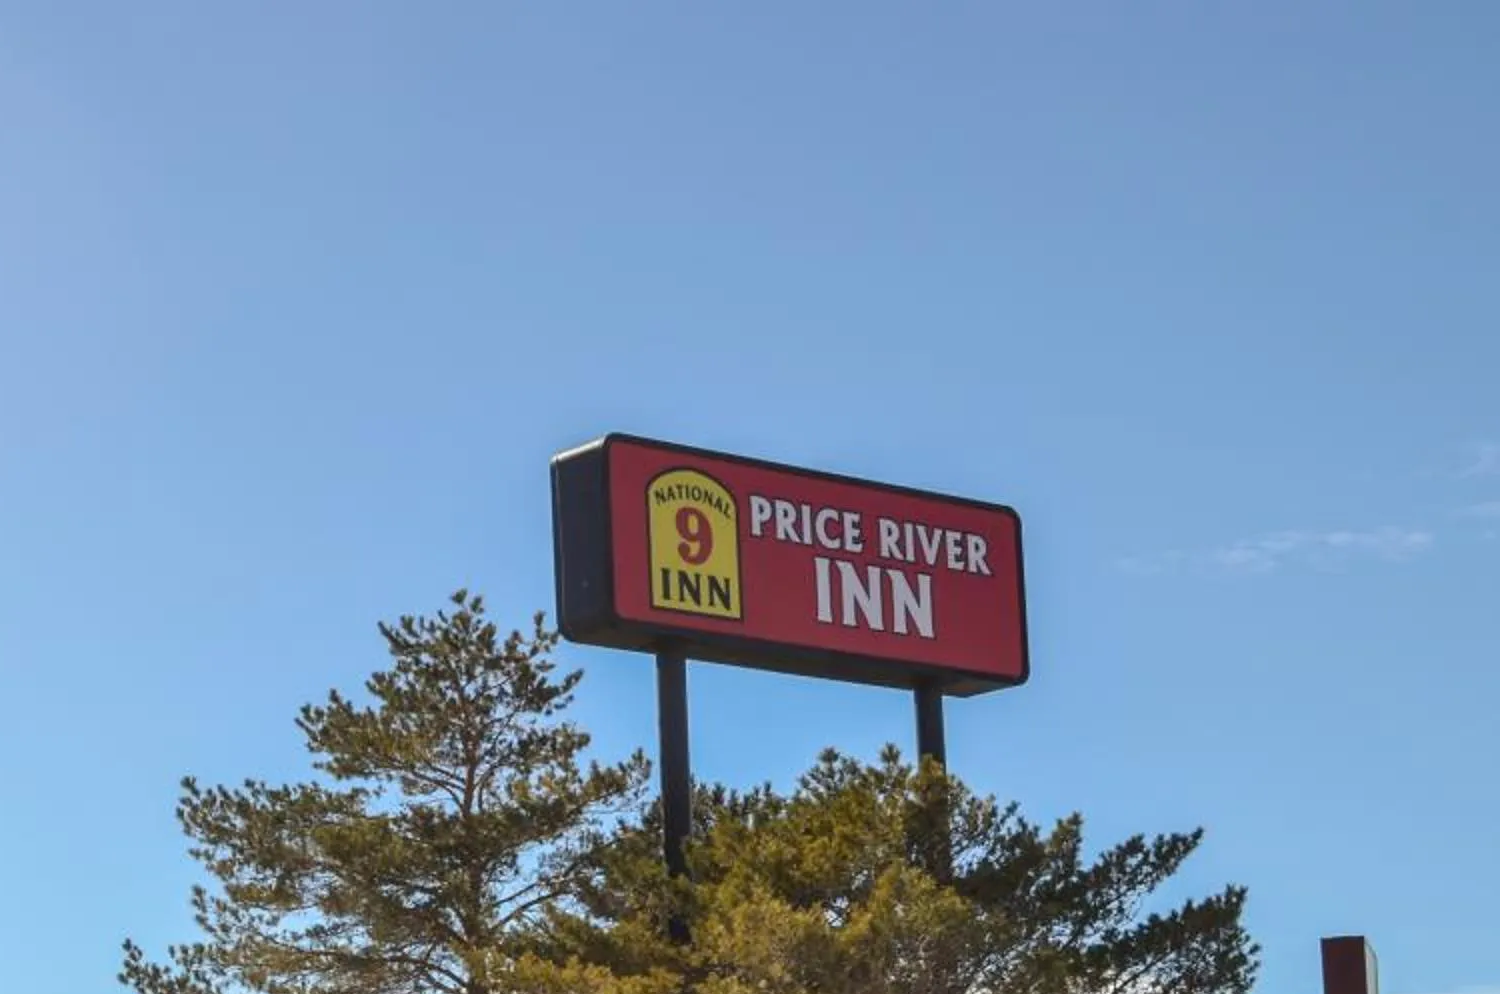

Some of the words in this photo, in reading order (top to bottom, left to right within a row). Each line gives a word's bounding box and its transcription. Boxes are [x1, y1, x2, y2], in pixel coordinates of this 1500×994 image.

[654, 483, 731, 519] NATIONAL
[675, 506, 713, 566] 9
[749, 495, 863, 553] PRICE
[879, 518, 991, 575] RIVER
[661, 567, 731, 611] INN
[814, 556, 935, 638] INN
